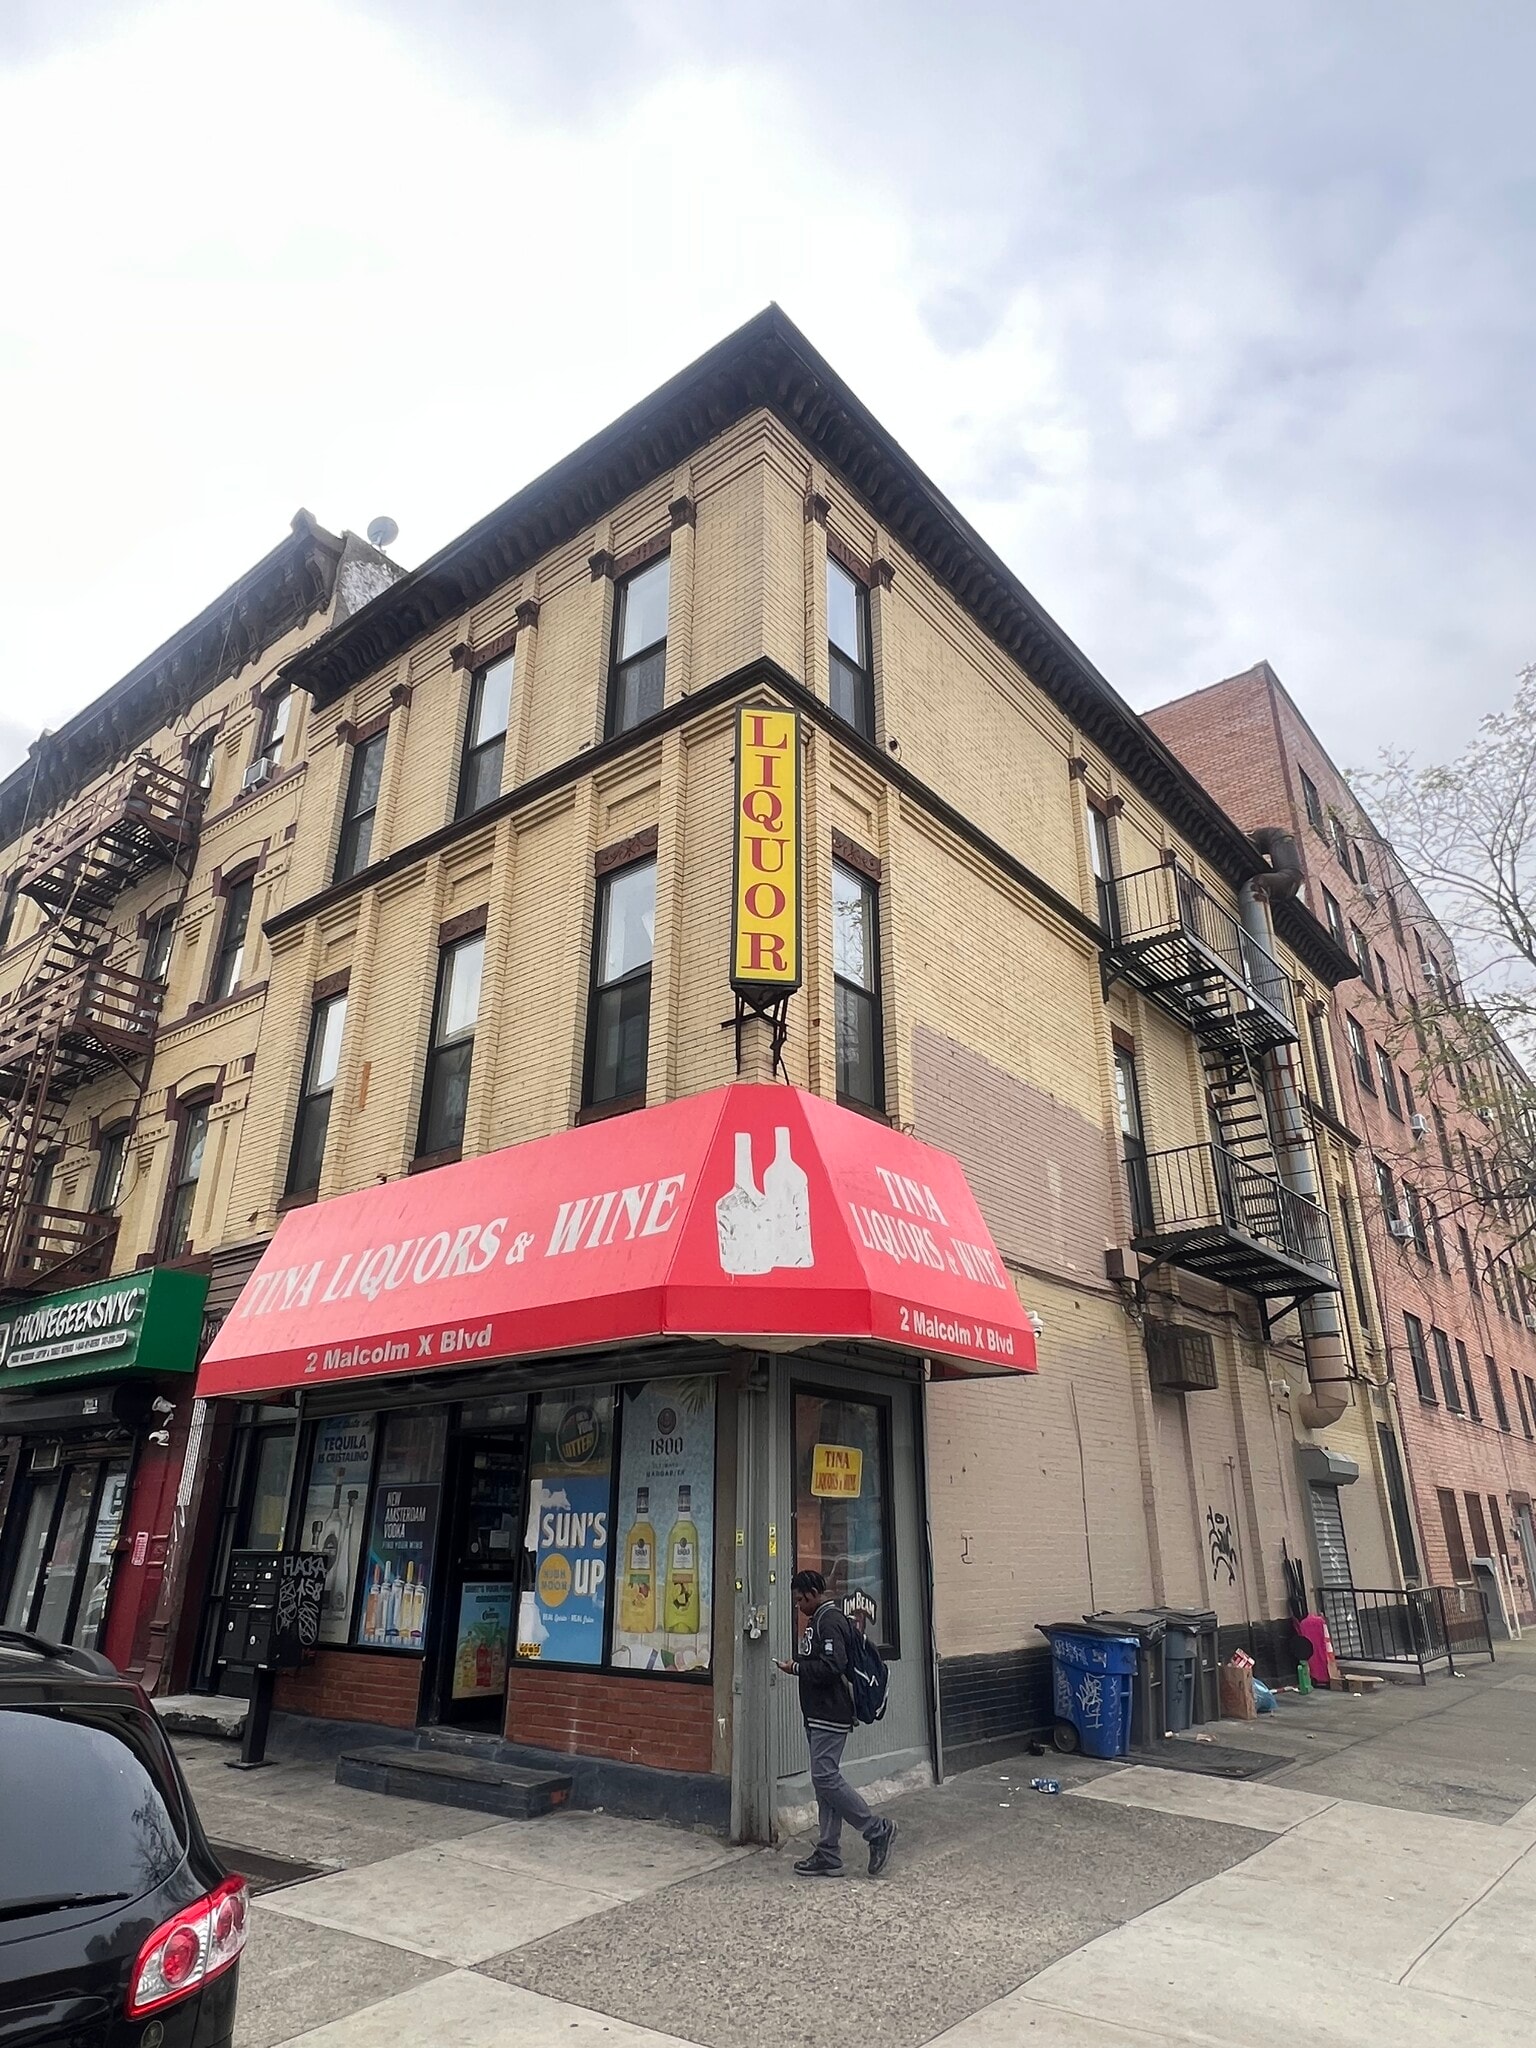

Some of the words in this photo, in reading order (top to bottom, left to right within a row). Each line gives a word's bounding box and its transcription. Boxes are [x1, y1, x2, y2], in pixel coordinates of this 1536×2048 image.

[741, 713, 791, 972] LIQUOR
[874, 1165, 950, 1228] TINA
[239, 1259, 326, 1319] TINA
[319, 1217, 510, 1303] LIQUORS
[504, 1231, 536, 1266] &
[543, 1172, 687, 1258] WINE
[847, 1201, 946, 1272] LIQUORS
[949, 1237, 1008, 1290] WINE
[10, 1287, 140, 1347] PHONEGEEKSNYC
[899, 1305, 910, 1331] 2
[912, 1309, 972, 1346] Malcolm
[973, 1324, 985, 1349] X
[986, 1328, 1014, 1355] Blvd
[304, 1352, 318, 1373] 2
[322, 1340, 410, 1370] Malcolm
[416, 1332, 434, 1357] X
[439, 1323, 493, 1353] Blvd
[324, 1435, 367, 1451] TEQUILA
[651, 1436, 683, 1456] 1800
[824, 1450, 851, 1469] TINA
[384, 1506, 427, 1523] AMSTERDAM
[386, 1491, 402, 1506] NEW
[383, 1522, 406, 1539] VODKA
[540, 1511, 607, 1549] SUN'S
[573, 1558, 606, 1597] UP
[843, 1597, 856, 1617] JIM
[855, 1591, 875, 1621] BEAM
